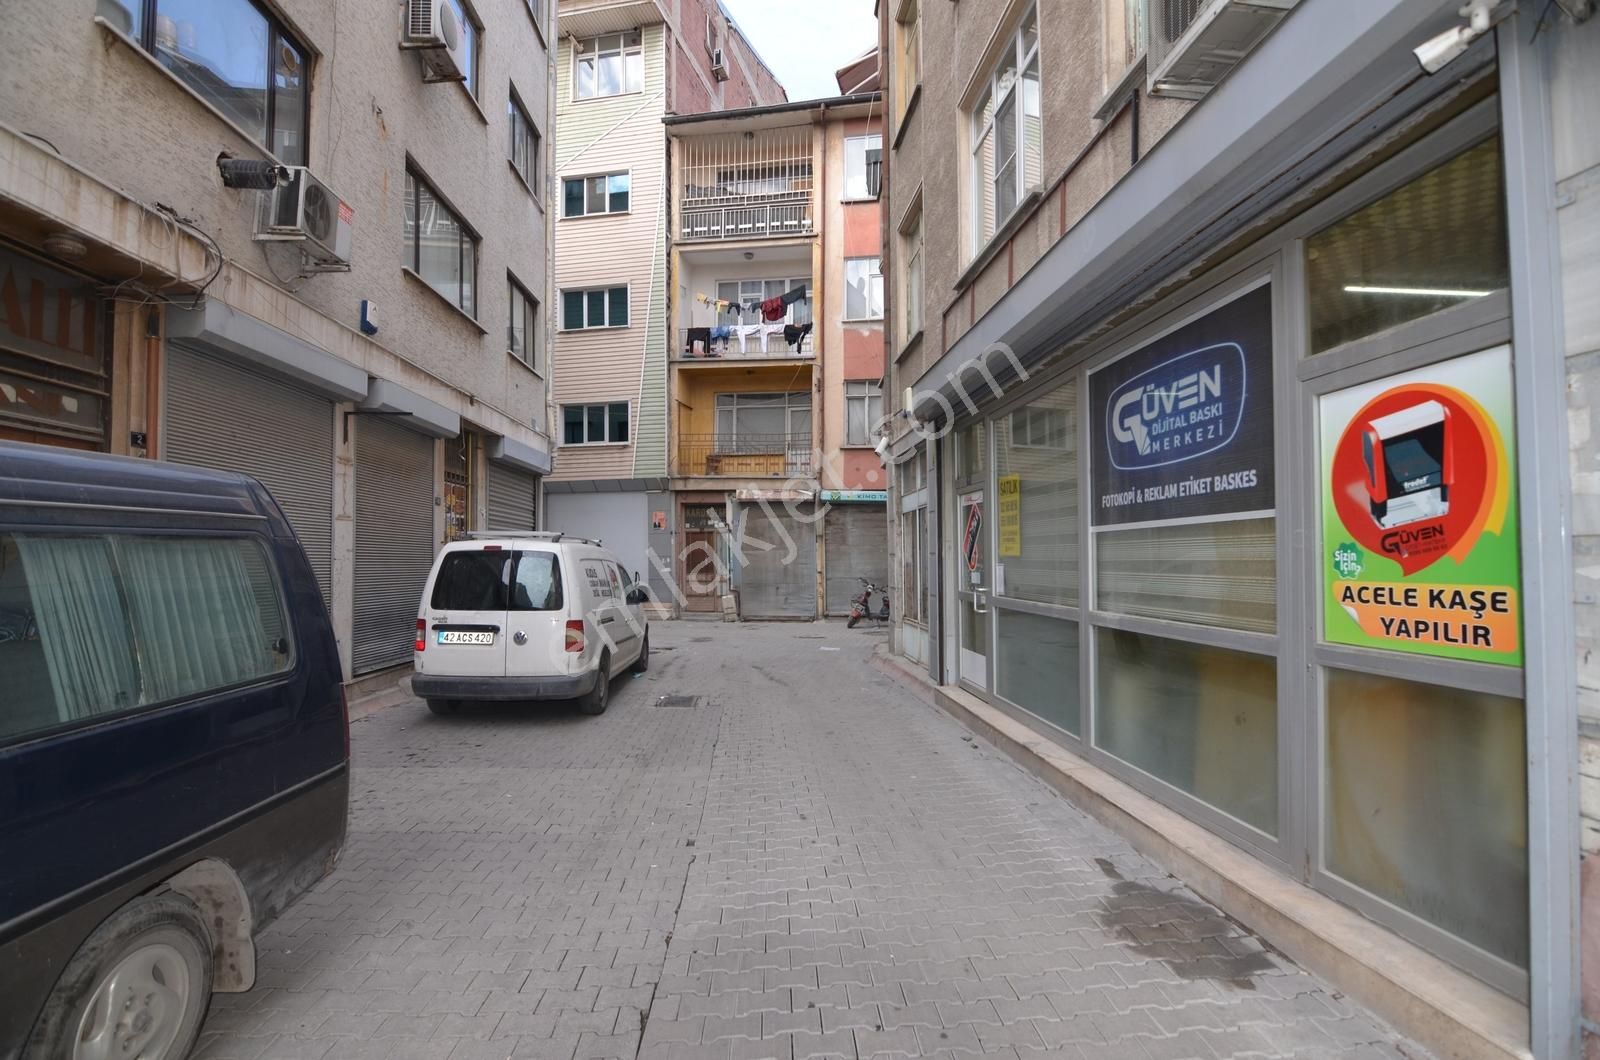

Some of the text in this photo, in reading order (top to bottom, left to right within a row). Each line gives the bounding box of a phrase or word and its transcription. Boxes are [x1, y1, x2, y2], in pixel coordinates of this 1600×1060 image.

[1112, 364, 1221, 455] GÜVEN
[1152, 402, 1223, 436] DİJİTAL BASKI
[1152, 420, 1223, 454] MERKEZİ
[1102, 469, 1258, 508] FOTOKOPİ & REKLAM ETİKET BASKES
[1381, 524, 1443, 557] GÜVEN
[1342, 586, 1509, 619] ACELE KAŞE
[444, 633, 492, 643] 42 ACS 420
[1380, 617, 1492, 647] YAPILIR
